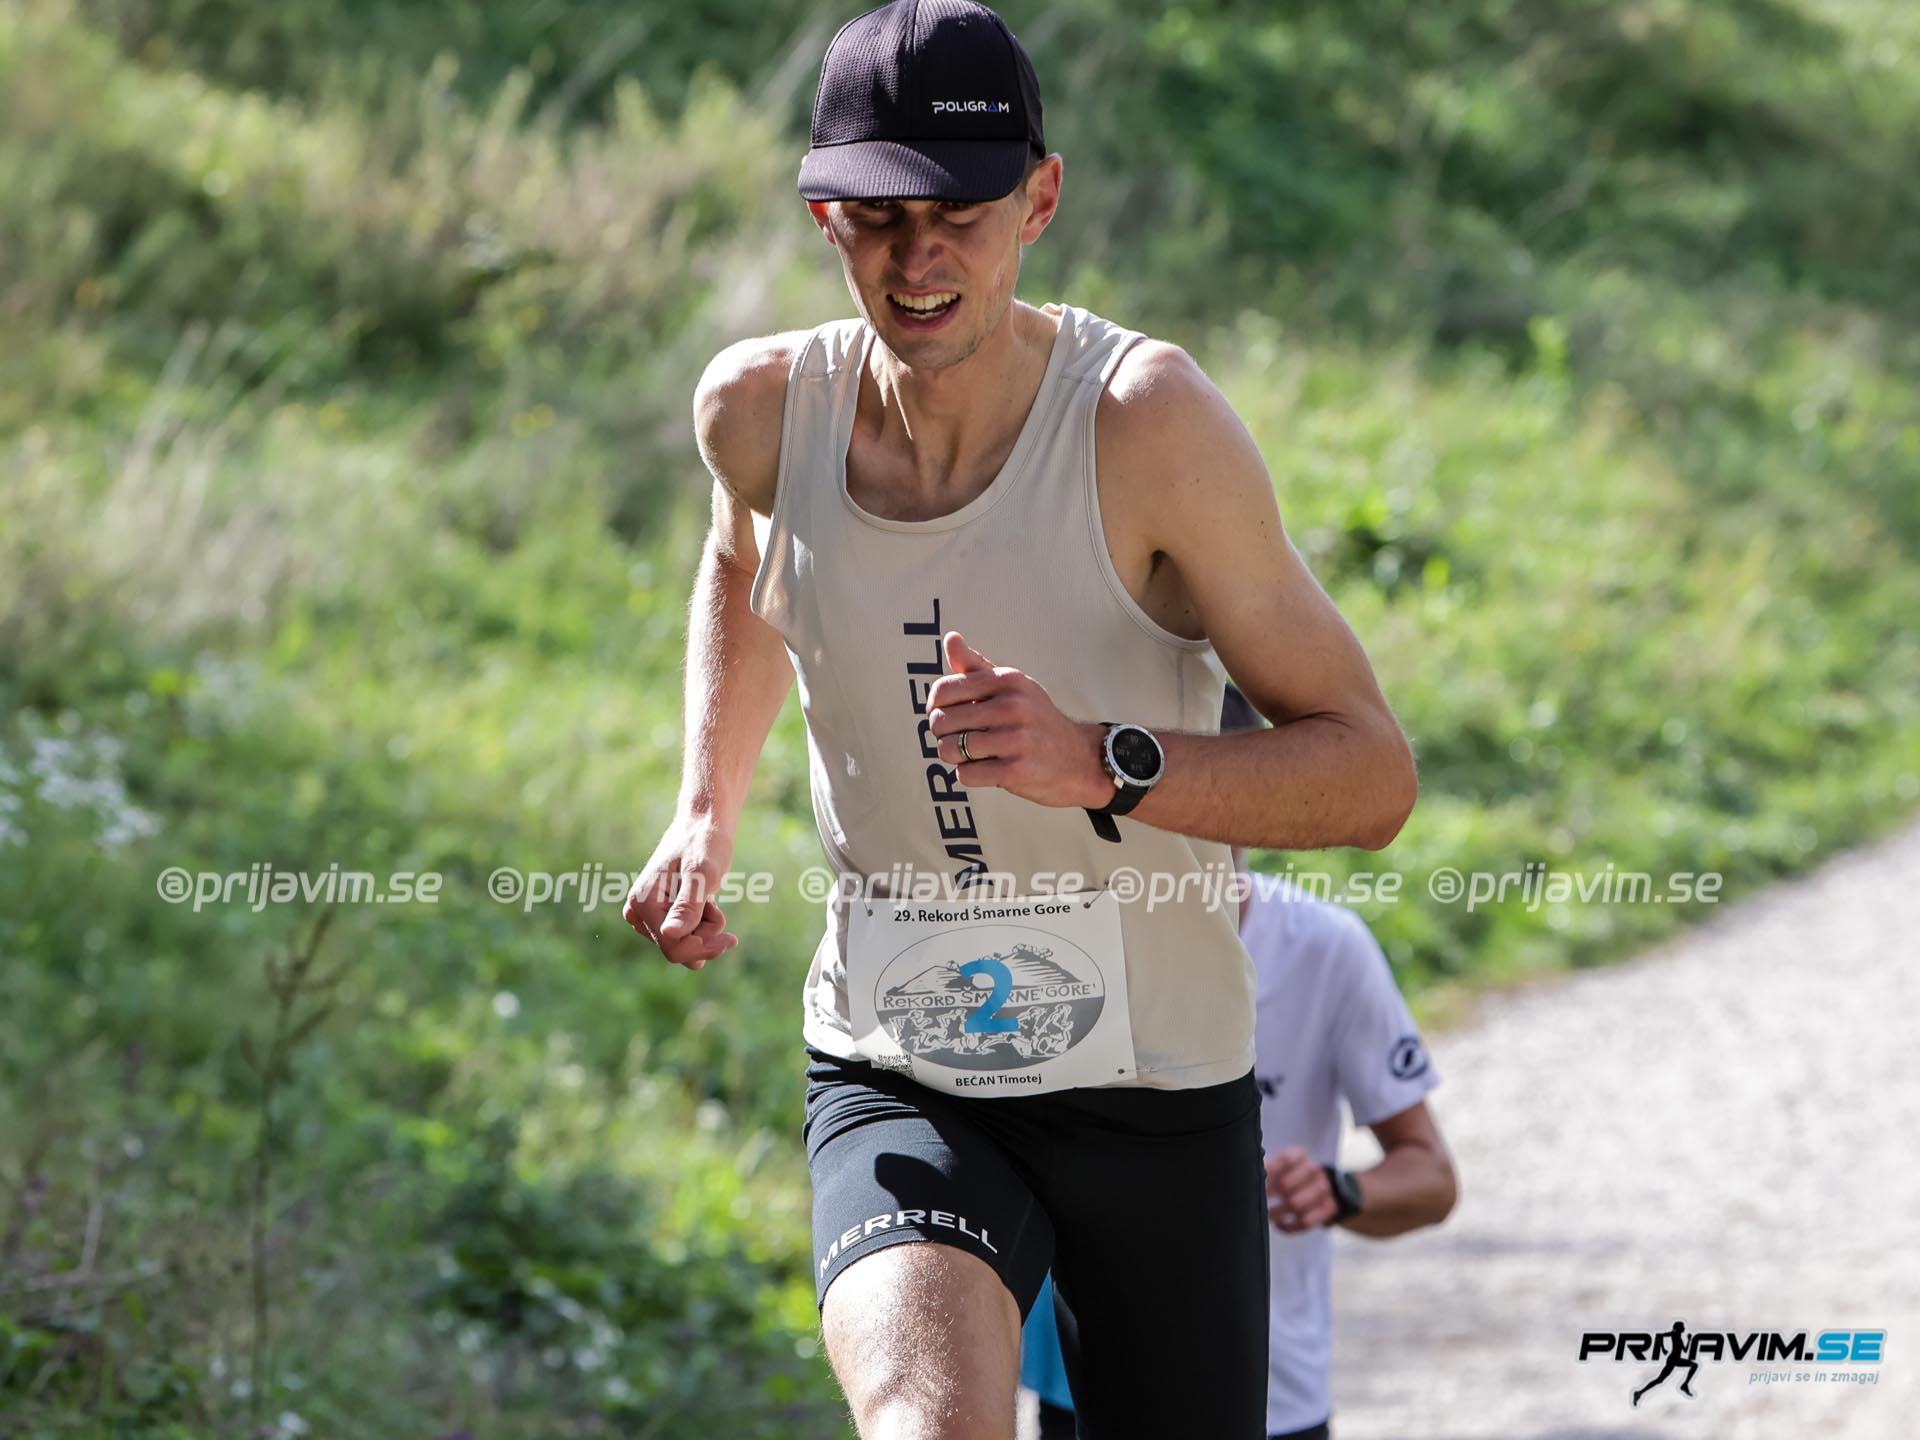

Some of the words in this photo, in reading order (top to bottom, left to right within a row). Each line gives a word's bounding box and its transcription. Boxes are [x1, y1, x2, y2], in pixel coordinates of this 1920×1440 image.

[932, 101, 1010, 114] POLIGRAM
[894, 909, 915, 922] 29.
[918, 908, 969, 922] Rekord
[973, 905, 1031, 920] Šmarne
[1034, 903, 1071, 915] Gore
[960, 985, 1042, 1004] ŠMRNE
[960, 959, 1020, 1034] 2
[955, 1076, 995, 1087] BEČAN
[998, 1072, 1042, 1086] Timotej
[819, 1209, 998, 1279] MERRELL
